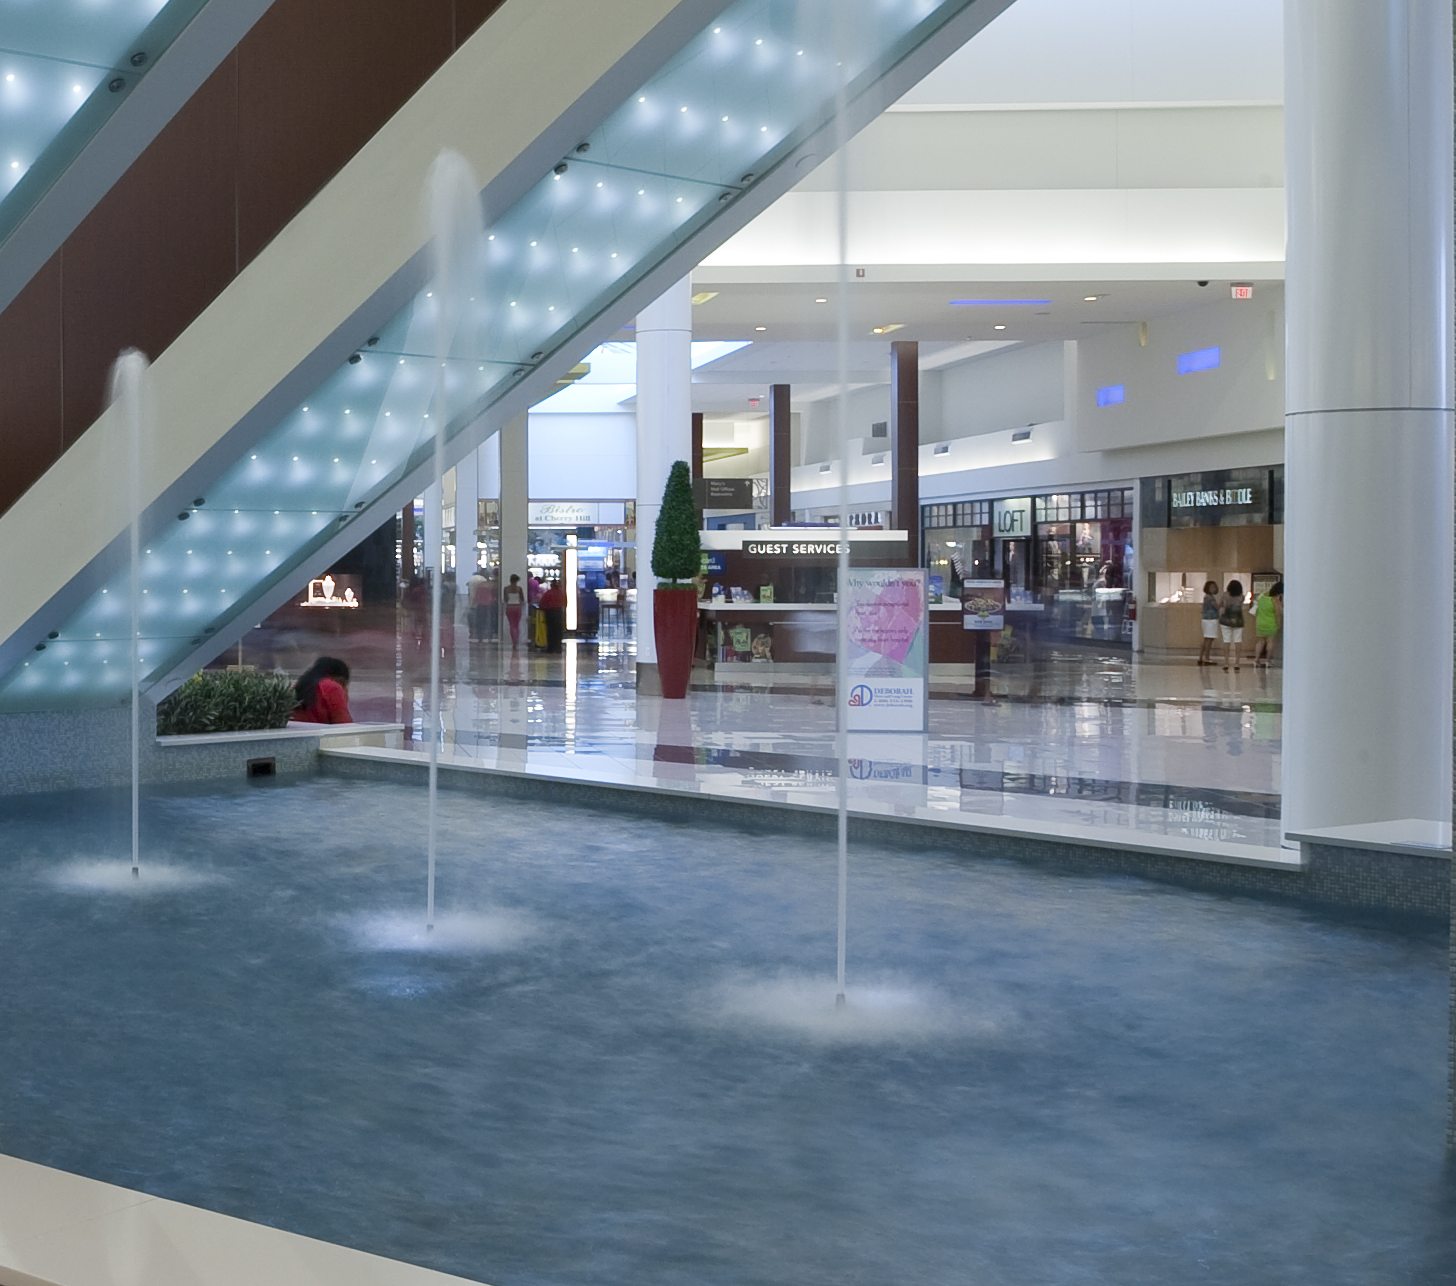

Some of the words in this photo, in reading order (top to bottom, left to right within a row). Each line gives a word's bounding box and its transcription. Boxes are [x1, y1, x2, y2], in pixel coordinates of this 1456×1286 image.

[1172, 491, 1195, 508] BAILEY
[1195, 490, 1219, 507] BANKS
[1219, 489, 1225, 505] &
[539, 504, 585, 514] Bistro
[544, 514, 573, 523] Cherry
[575, 514, 591, 522] Hill
[998, 509, 1026, 533] LOFT
[747, 543, 789, 554] GUEST
[792, 543, 851, 554] SERVICES
[865, 578, 900, 587] wouldn't
[900, 578, 921, 590] you?
[873, 687, 913, 695] DEBORAH
